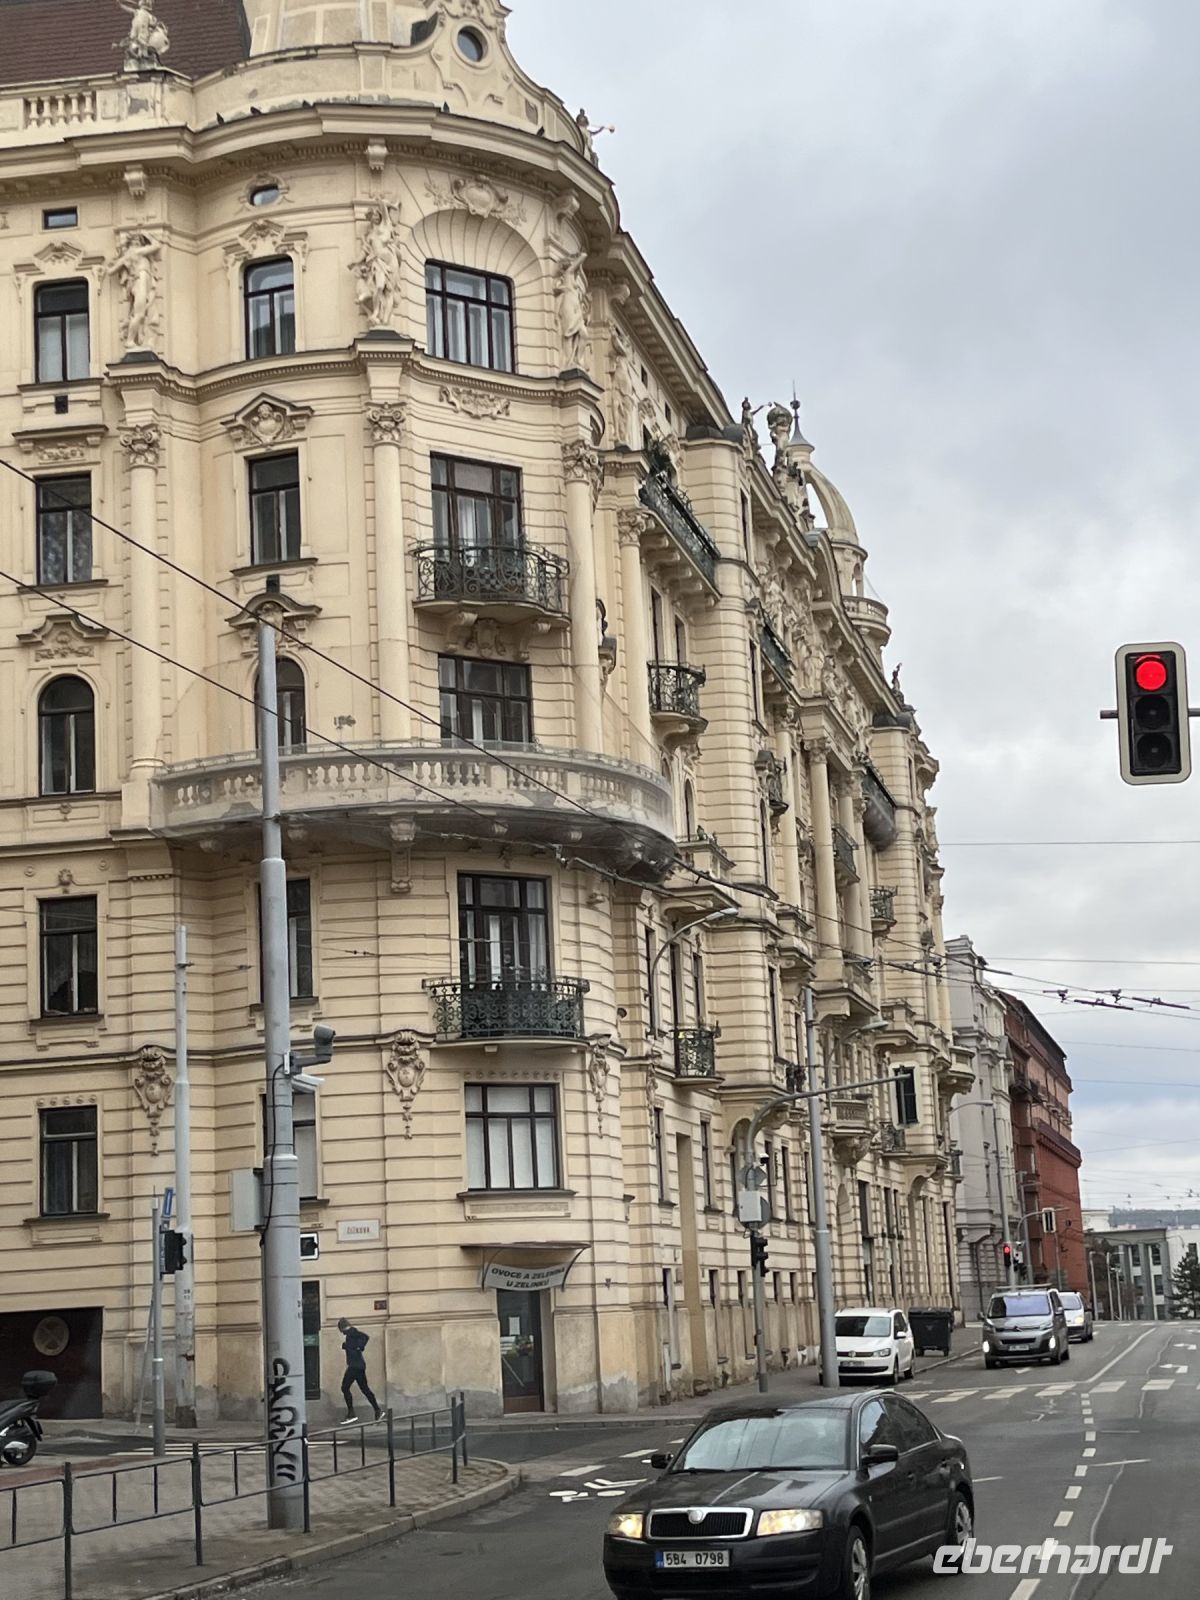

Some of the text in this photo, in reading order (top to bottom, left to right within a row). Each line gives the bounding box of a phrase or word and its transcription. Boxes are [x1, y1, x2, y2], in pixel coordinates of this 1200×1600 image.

[491, 1267, 522, 1279] OVOCE
[665, 1552, 724, 1566] 5B4 0798
